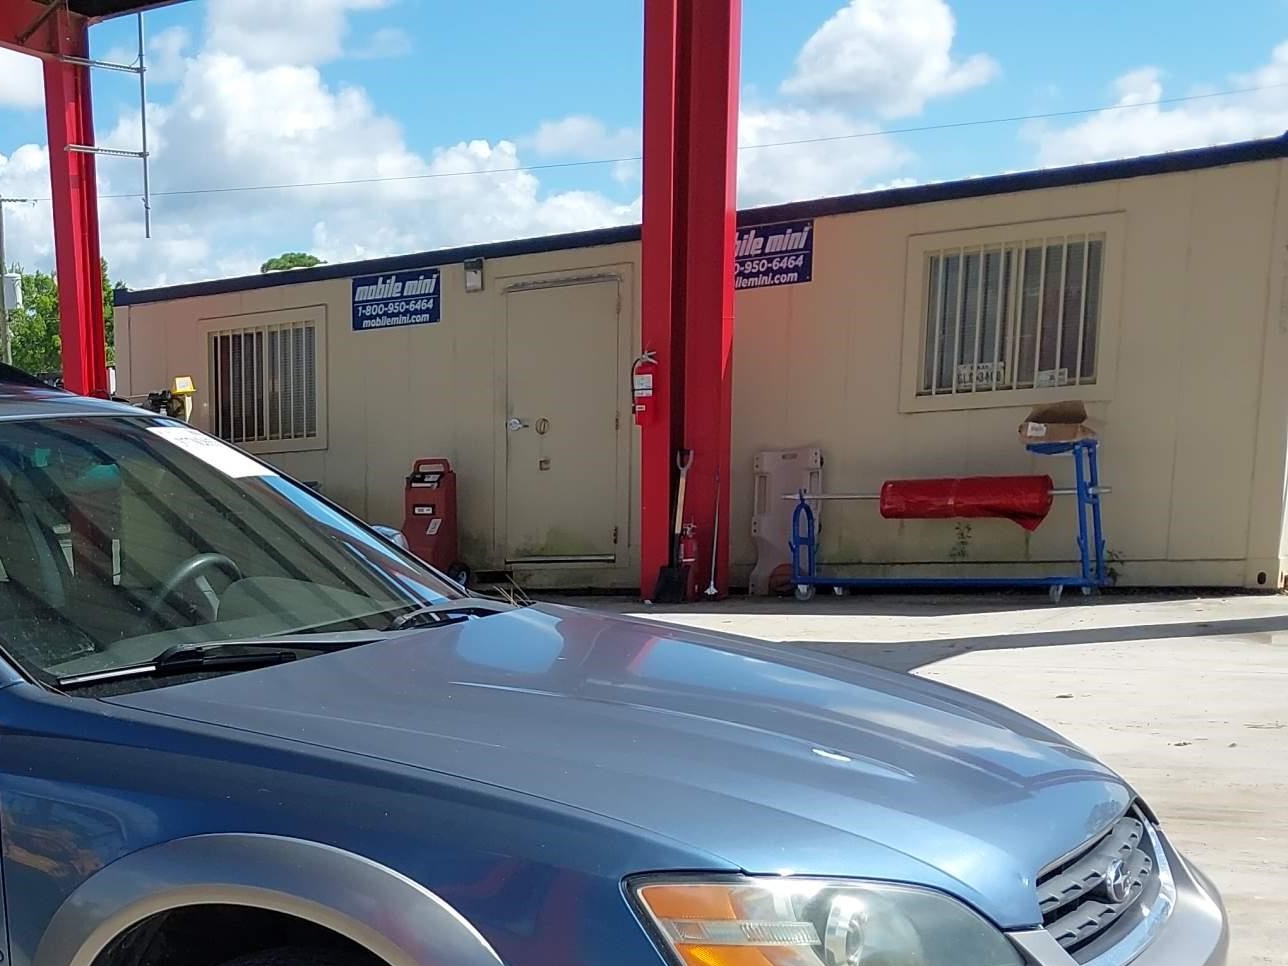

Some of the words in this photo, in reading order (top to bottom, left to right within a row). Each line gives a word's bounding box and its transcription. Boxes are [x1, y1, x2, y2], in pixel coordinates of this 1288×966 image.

[765, 226, 810, 253] mini
[734, 255, 804, 275] 0-950-6464
[355, 275, 403, 302] mobile
[403, 273, 439, 296] mini
[735, 272, 798, 289] ilemini.com
[358, 298, 434, 317] 1-800-950-6464
[362, 314, 430, 328] mobilemini.com
